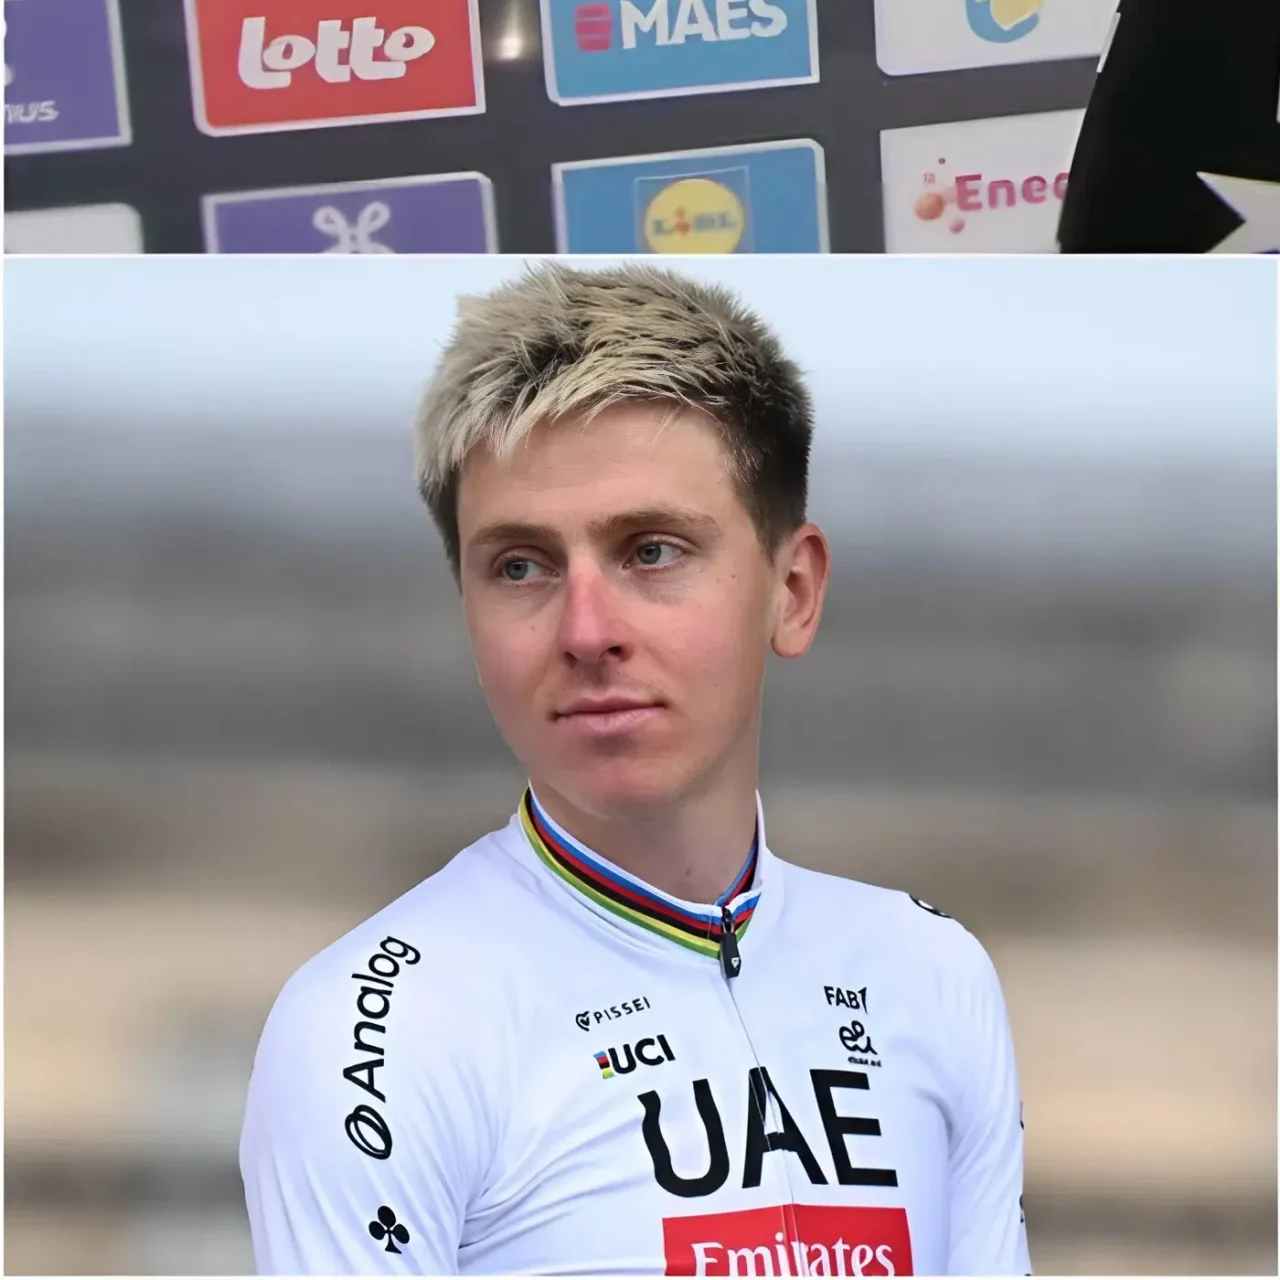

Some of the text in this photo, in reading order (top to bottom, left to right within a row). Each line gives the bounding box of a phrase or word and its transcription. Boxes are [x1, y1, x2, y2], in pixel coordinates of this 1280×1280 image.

[342, 935, 421, 1104] Analog
[593, 996, 651, 1024] PISSEI
[608, 1034, 676, 1075] UCI
[637, 1066, 899, 1198] UAE
